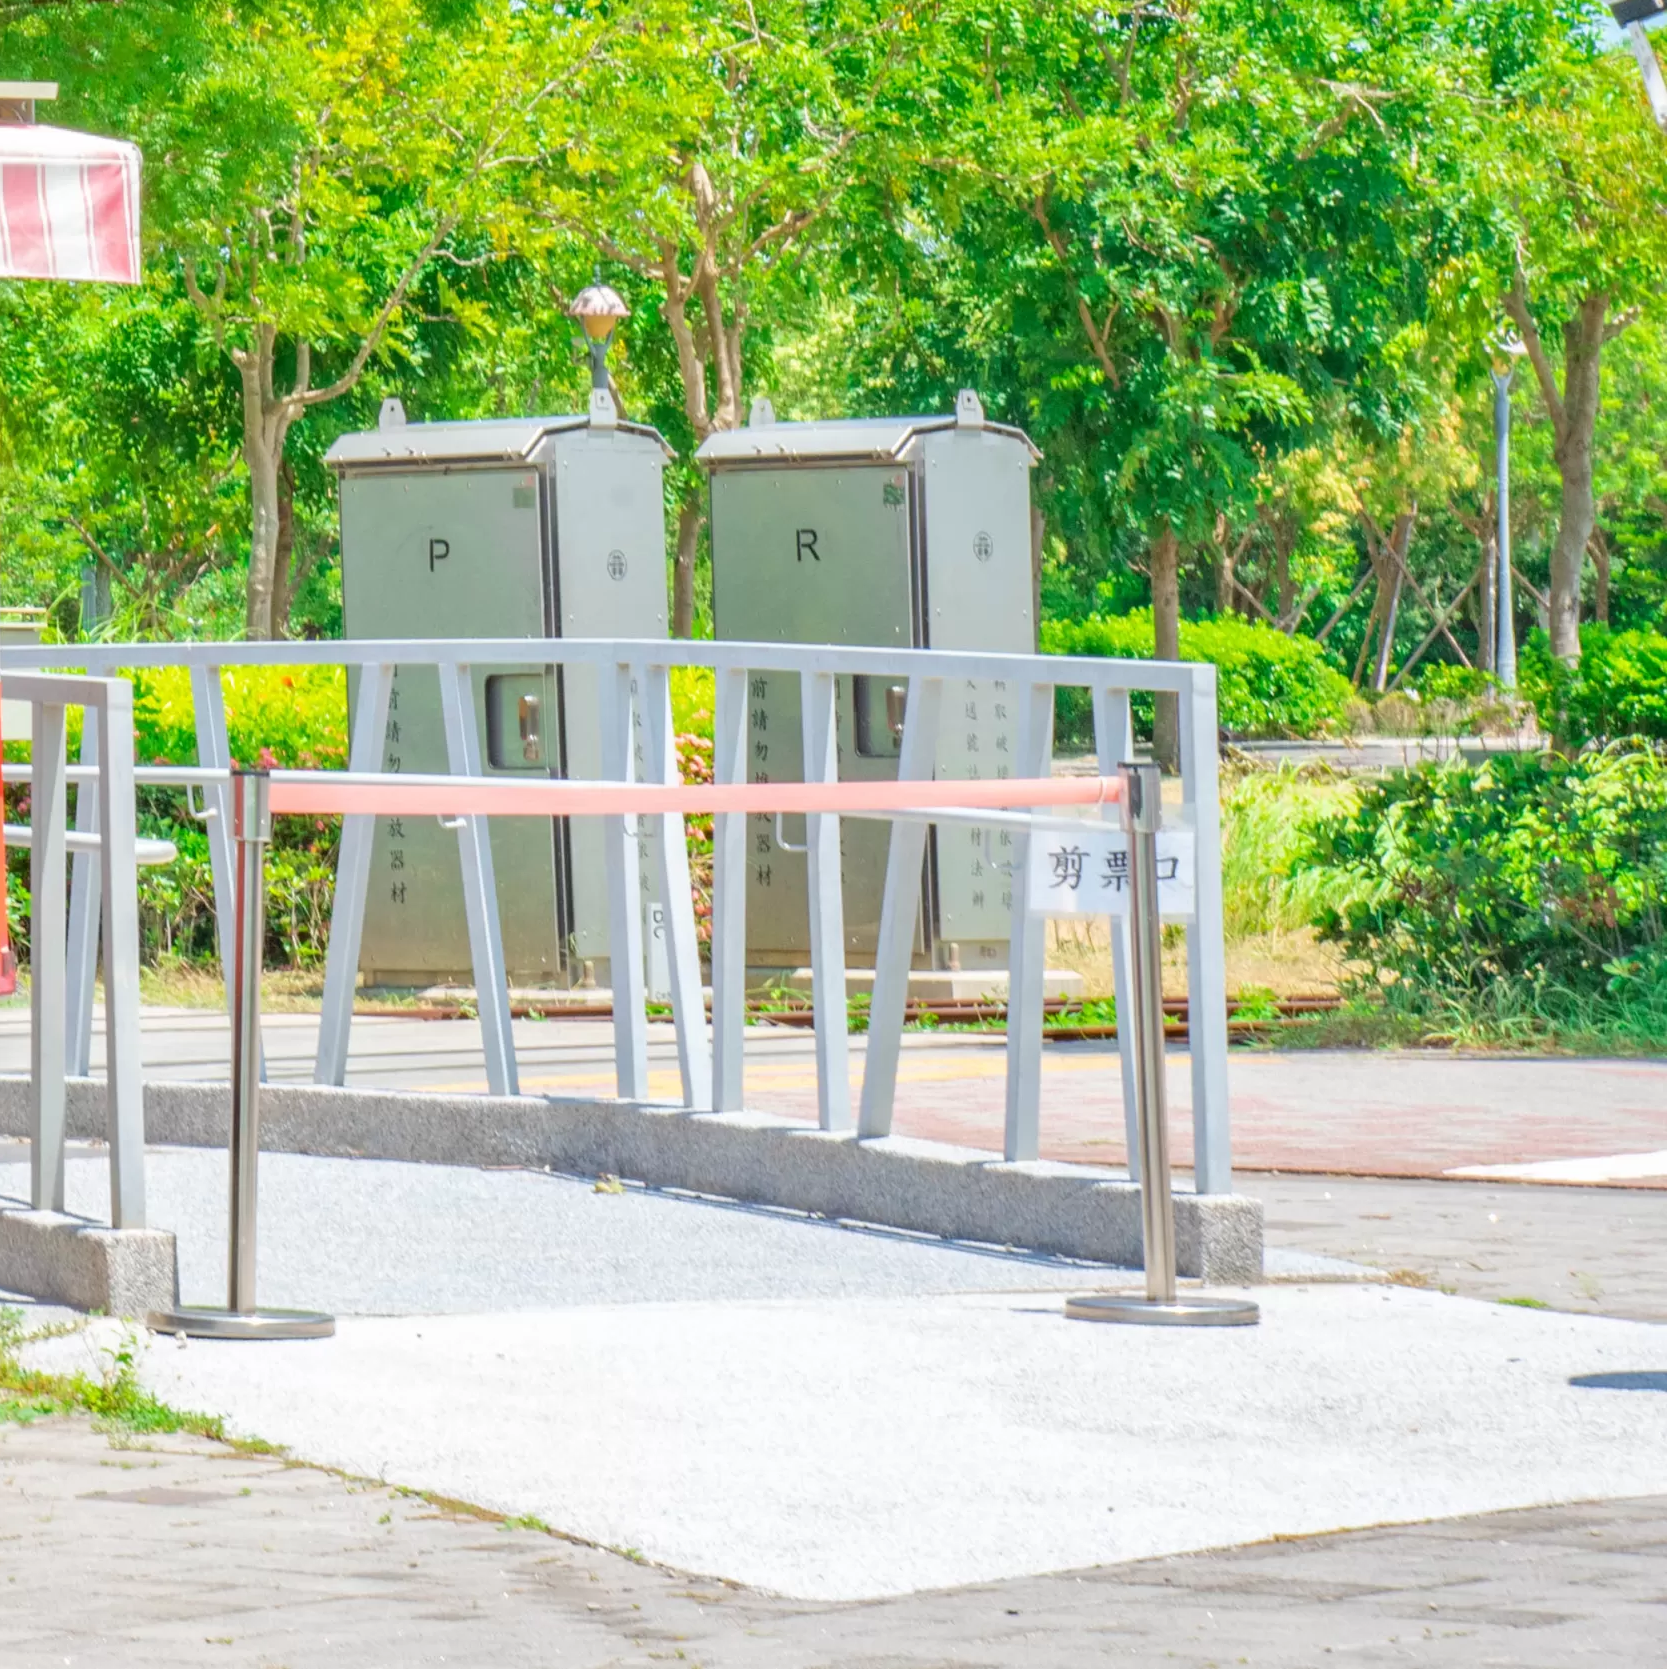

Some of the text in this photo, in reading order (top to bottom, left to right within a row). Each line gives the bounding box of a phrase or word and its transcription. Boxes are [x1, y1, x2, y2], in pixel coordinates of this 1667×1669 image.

[430, 538, 450, 572] P
[796, 528, 820, 562] R
[1048, 845, 1179, 892] 剪票口
